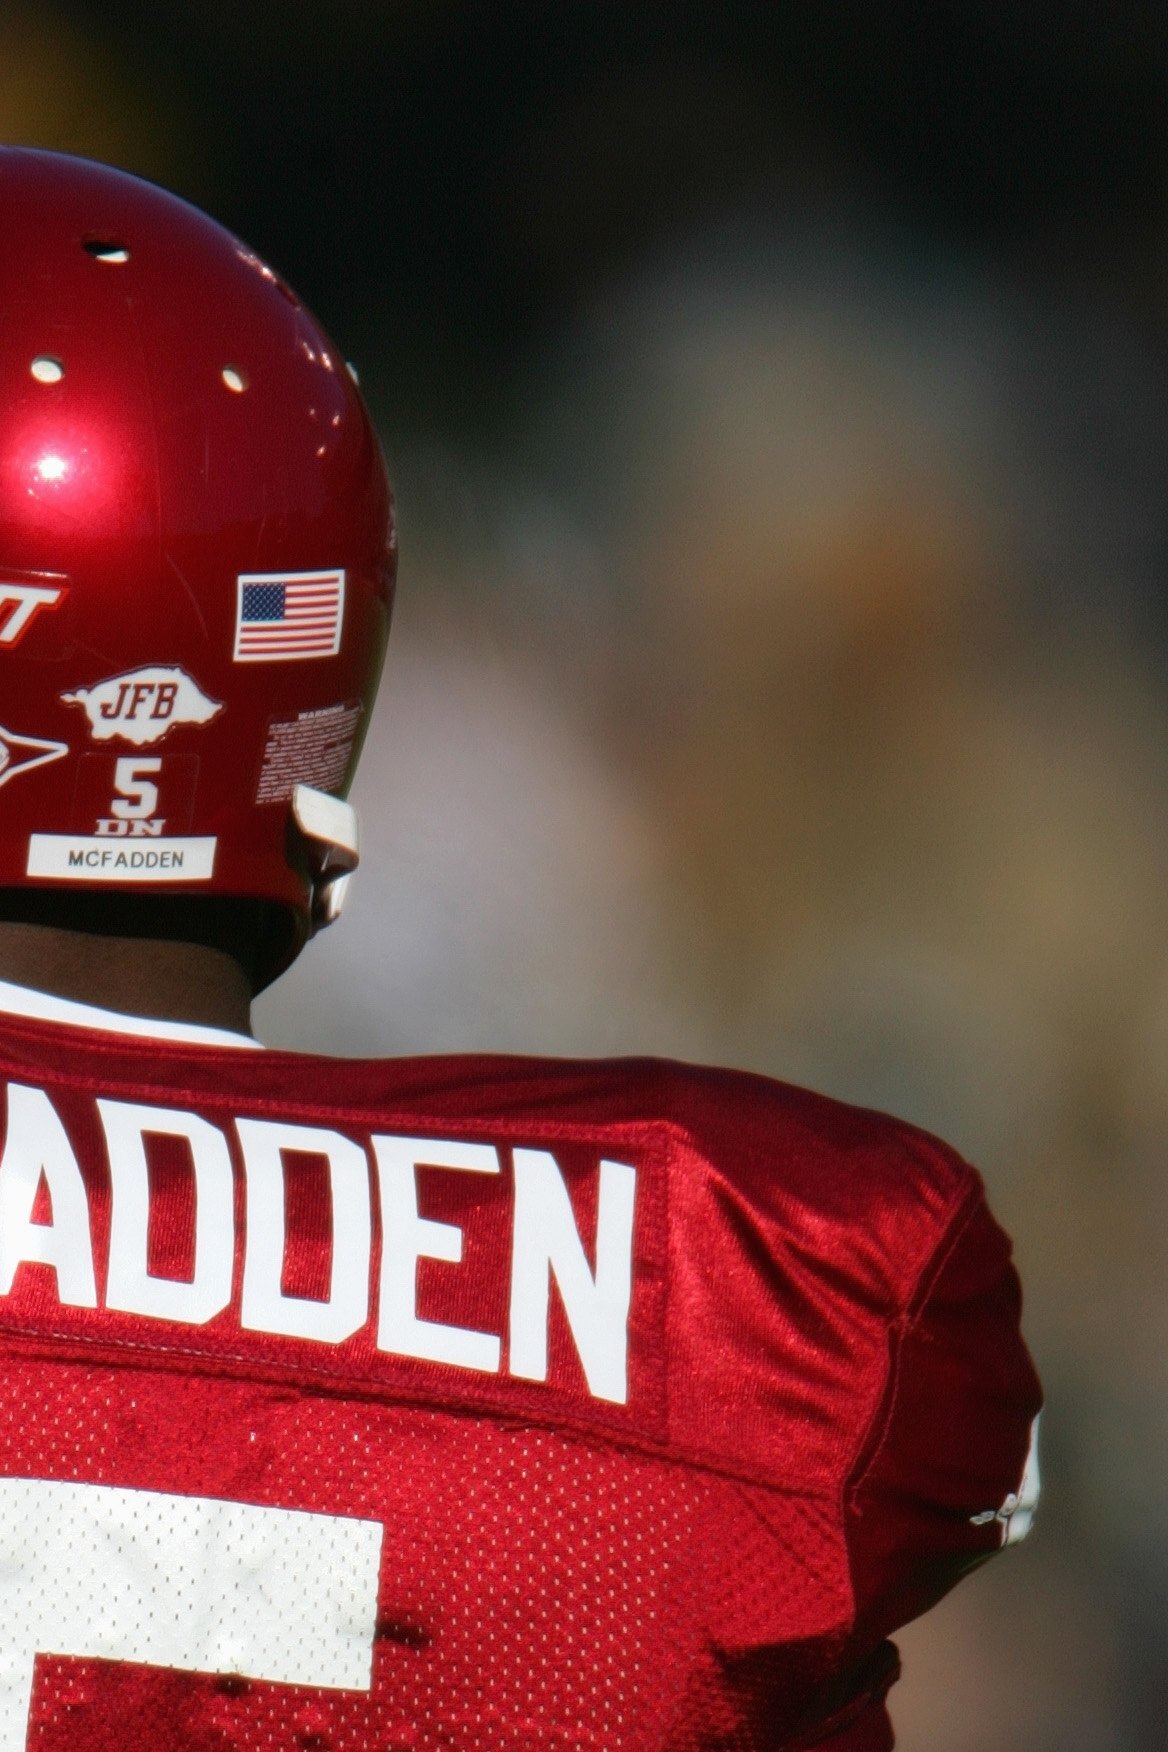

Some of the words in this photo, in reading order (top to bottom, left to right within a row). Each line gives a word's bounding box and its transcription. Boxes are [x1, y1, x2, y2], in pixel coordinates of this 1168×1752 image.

[100, 683, 179, 719] JFB
[111, 757, 162, 819] 5
[68, 850, 184, 868] MCFADDEN
